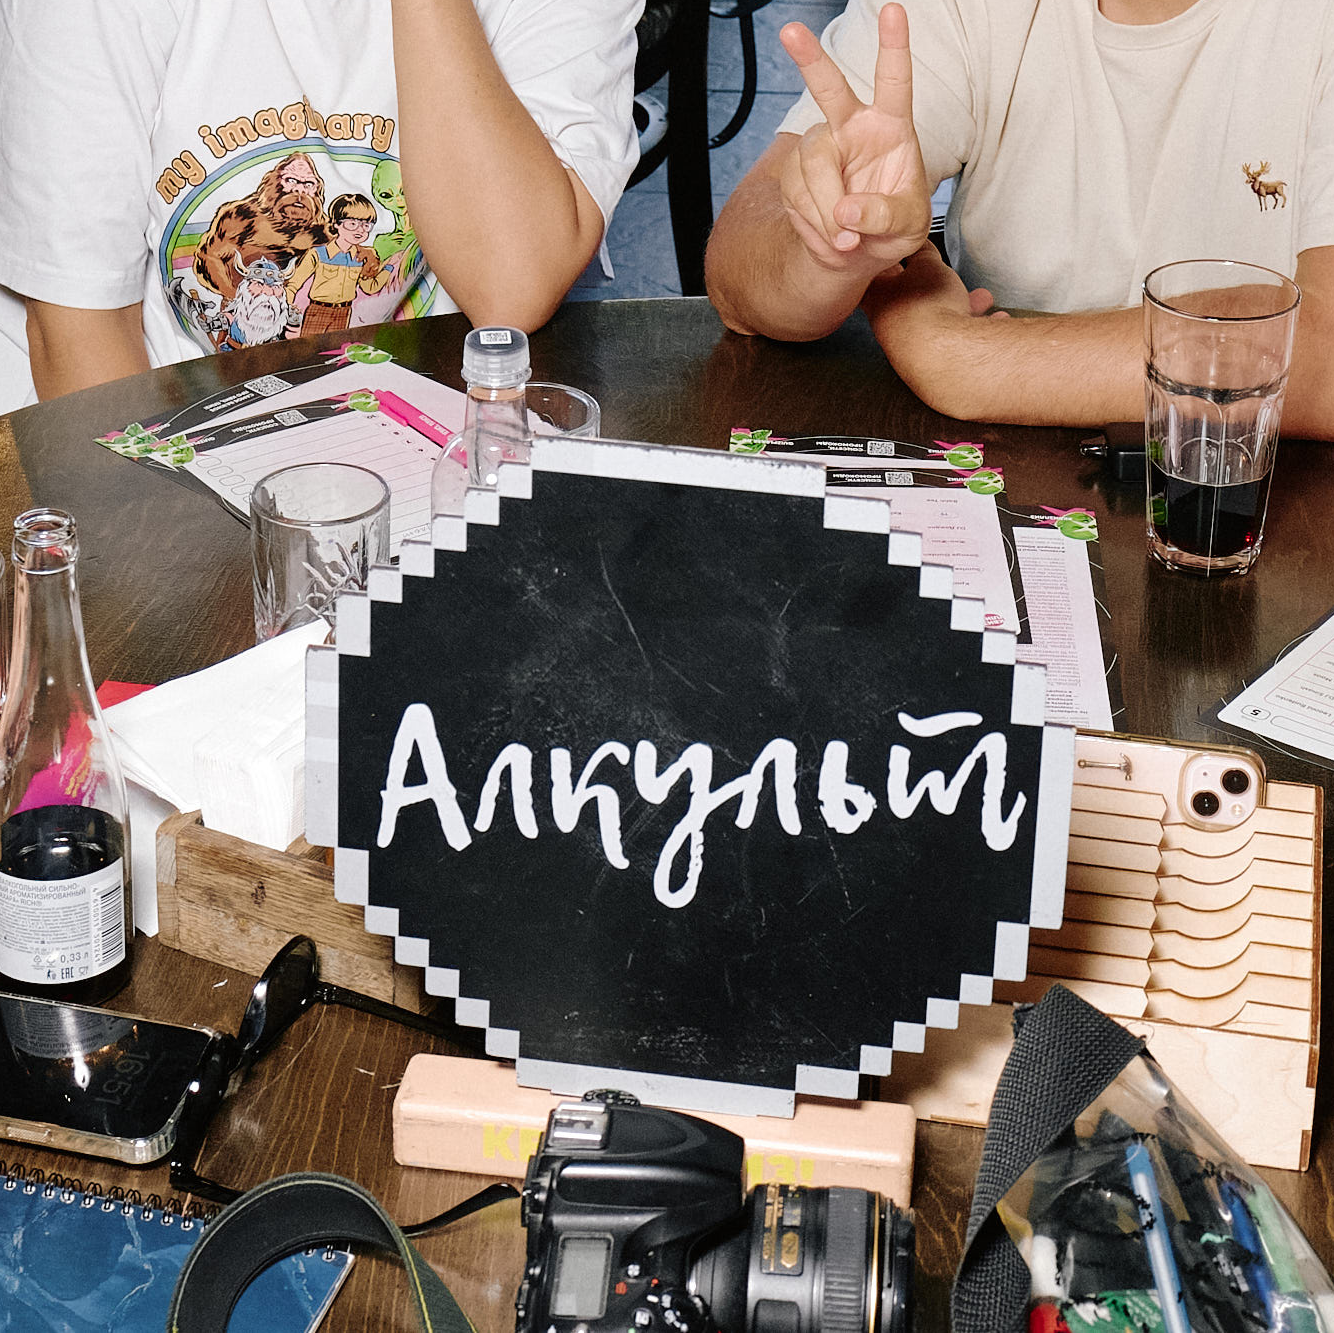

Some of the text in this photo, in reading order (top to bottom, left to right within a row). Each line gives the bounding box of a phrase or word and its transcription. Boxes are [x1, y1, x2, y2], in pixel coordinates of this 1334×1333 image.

[155, 149, 207, 205] my
[1248, 708, 1262, 716] 5
[60, 952, 82, 964] 0,33
